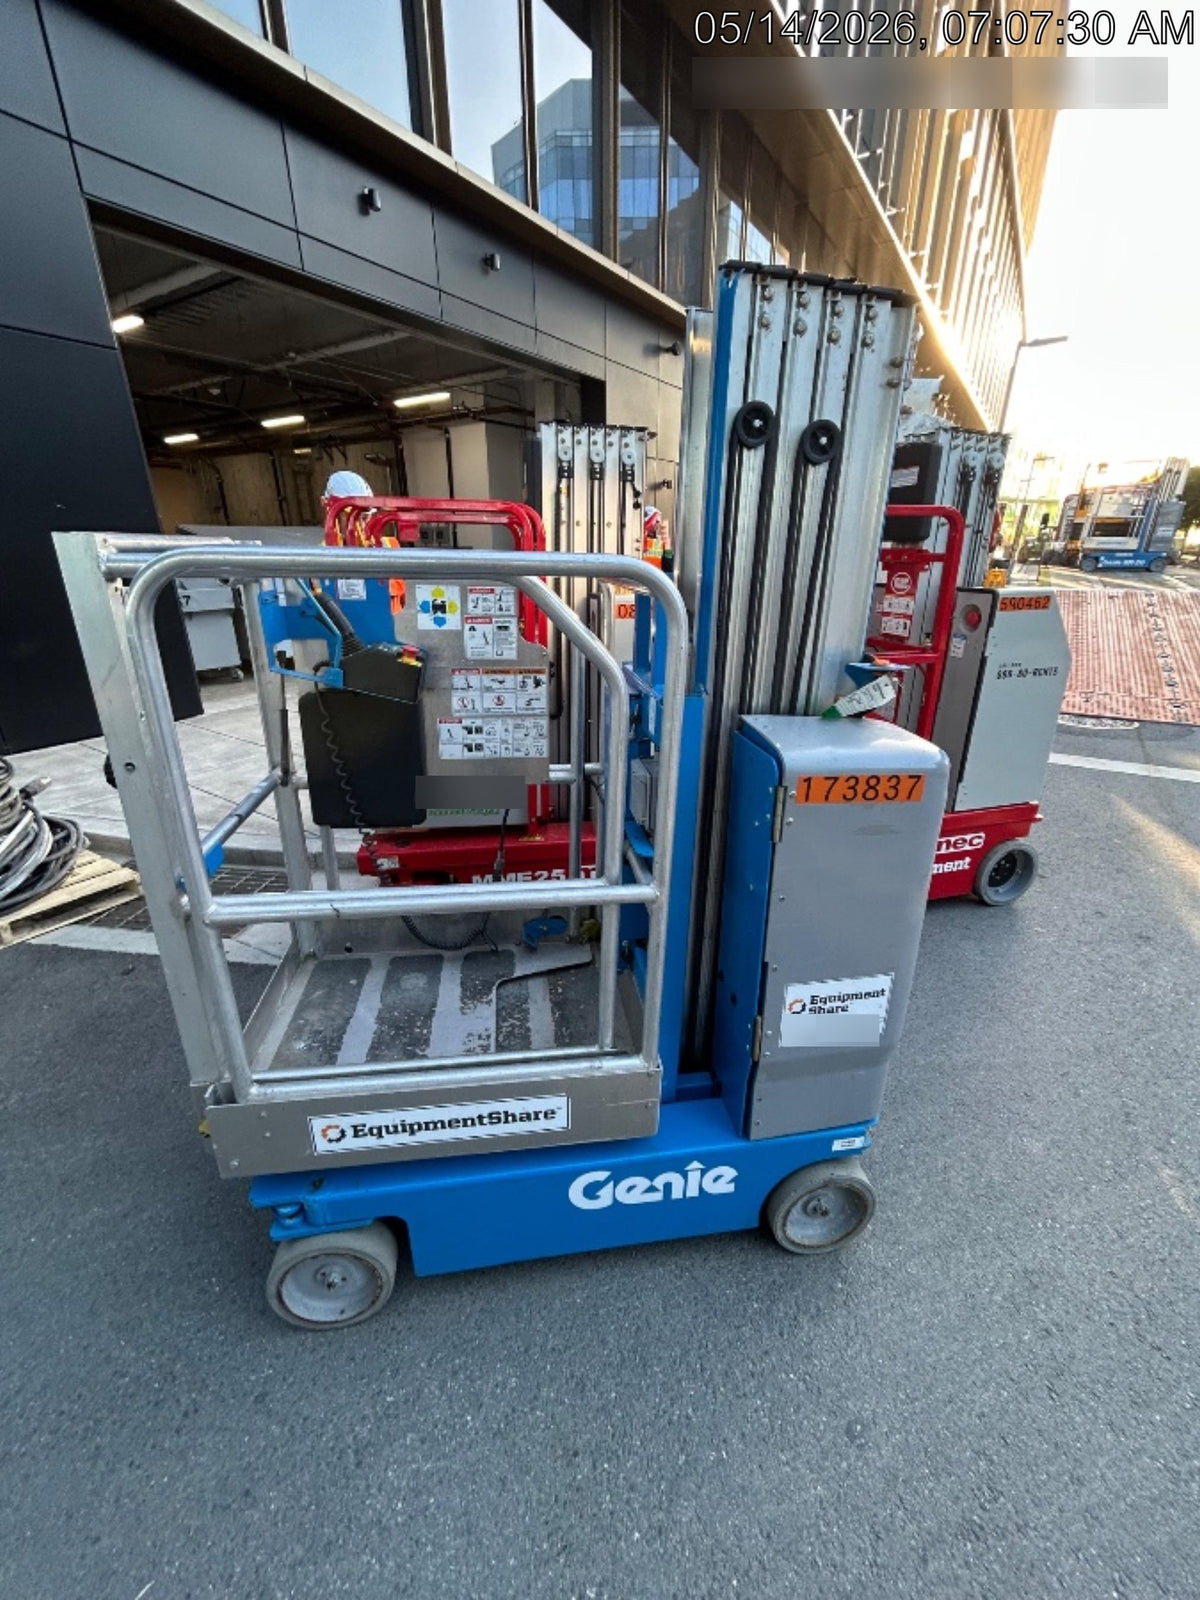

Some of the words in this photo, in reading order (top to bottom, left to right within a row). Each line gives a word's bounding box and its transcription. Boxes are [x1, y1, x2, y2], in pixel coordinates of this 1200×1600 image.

[999, 595, 1051, 612] 590462
[802, 774, 923, 803] 173837
[809, 987, 886, 1006] Equipment
[807, 1003, 850, 1015] Share
[568, 1159, 740, 1211] Genie
